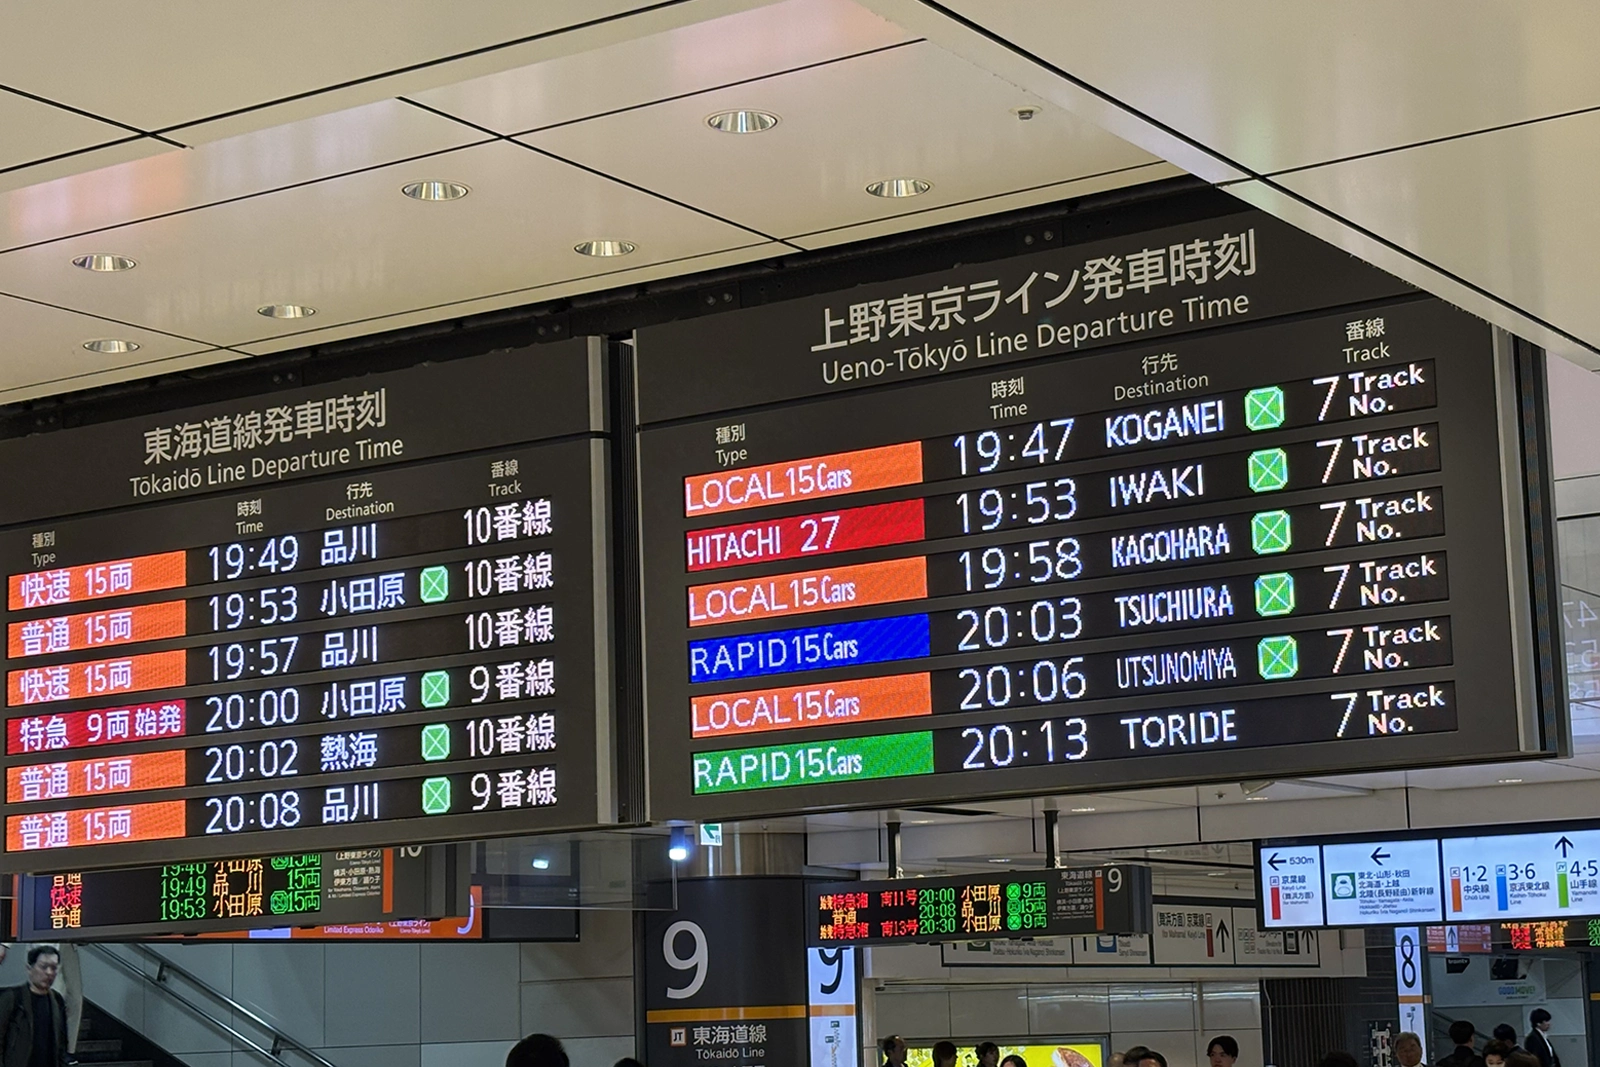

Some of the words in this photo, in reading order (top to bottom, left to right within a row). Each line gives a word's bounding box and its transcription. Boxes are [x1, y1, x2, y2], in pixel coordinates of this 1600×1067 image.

[810, 228, 1256, 353] 上野東京ライン発車時刻
[821, 338, 968, 385] Ueno-Tōkyō
[975, 329, 1028, 359] Line
[1037, 306, 1174, 349] Departure
[1181, 293, 1250, 324] Time
[1345, 316, 1386, 342] 番線
[1141, 352, 1178, 376] 行先
[1342, 341, 1391, 365] Track
[991, 376, 1025, 400] 時刻
[1113, 372, 1209, 401] Destination
[989, 400, 1028, 421] Time
[1349, 394, 1394, 417] No.
[143, 387, 388, 466] 東海道線発車時刻
[954, 418, 1076, 476] 19:47
[1105, 400, 1225, 448] KOGANEI
[1312, 376, 1340, 421] 7
[1348, 363, 1426, 394] Track
[715, 423, 746, 445] 種別
[130, 465, 202, 498] Tōkaidō
[207, 460, 246, 486] Line
[251, 447, 351, 481] Departure
[355, 436, 404, 465] Time
[714, 446, 748, 467] Type
[490, 459, 519, 479] 番線
[1353, 457, 1397, 480] No.
[346, 481, 374, 500] 行先
[488, 479, 522, 497] Track
[687, 525, 782, 567] HITACHI
[800, 515, 841, 553] 27
[956, 478, 1077, 533] 19:53
[1109, 464, 1205, 507] IWAKI
[1316, 438, 1343, 484] 7
[1351, 427, 1429, 456] Track
[236, 498, 263, 518] 時刻
[325, 498, 395, 522] Destination
[235, 517, 264, 535] Time
[1356, 520, 1402, 543] No.
[32, 530, 56, 548] 種別
[959, 537, 1084, 592] 19:58
[1111, 522, 1231, 568] KAGOHARA
[1320, 501, 1347, 546] 7
[1355, 490, 1433, 520] Track
[20, 568, 71, 608] 快速
[85, 560, 133, 596] 15両
[208, 534, 299, 582] 19:49
[320, 522, 378, 567] 品川
[463, 498, 554, 546] 10番線
[31, 549, 56, 568] Type
[20, 618, 71, 657] 普通
[85, 610, 133, 645] 15両
[208, 584, 299, 632] 19:53
[320, 571, 407, 617] 小田原
[463, 551, 555, 598] 10番線
[956, 597, 1083, 651] 20:03
[1114, 584, 1234, 628] TSUCHIURA
[1323, 564, 1350, 610] 7
[1359, 555, 1437, 583] Track
[1360, 583, 1406, 606] No.
[20, 664, 71, 704] 快速
[85, 657, 133, 692] 15両
[208, 636, 300, 682] 19:57
[320, 625, 378, 668] 品川
[464, 606, 555, 652] 10番線
[958, 656, 1087, 711] 20:06
[1116, 646, 1237, 690] UTSUNOMIYA
[1326, 628, 1354, 674] 7
[1362, 620, 1441, 648] Track
[1363, 648, 1409, 671] No.
[19, 714, 70, 752] 特急
[87, 706, 131, 744] 9両
[134, 704, 182, 738] 始発
[205, 687, 300, 733] 20:00
[320, 673, 407, 720] 小田原
[1368, 712, 1414, 735] No.
[961, 717, 1089, 770] 20:13
[1120, 709, 1238, 750] TORIDE
[1331, 692, 1358, 738] 7
[1366, 685, 1445, 712] Track
[20, 762, 70, 801] 普通
[83, 756, 132, 792] 15両
[205, 738, 300, 784] 20:02
[321, 731, 379, 772] 熱海
[465, 712, 557, 759] 10番線
[19, 812, 70, 850] 普通
[83, 806, 132, 842] 15両
[204, 790, 301, 835] 20:08
[322, 782, 379, 825] 品川
[1289, 857, 1315, 865] 530m
[160, 875, 207, 899] 19:49
[287, 867, 322, 890] 15両
[1107, 867, 1123, 893] 9
[1281, 875, 1307, 885] 京葉線
[1463, 883, 1490, 895] 中央線
[1509, 881, 1551, 893] 京浜東北線
[1570, 879, 1598, 890] 山手線
[160, 897, 207, 921] 19:53
[212, 893, 264, 919] 小田原
[287, 889, 321, 912] 15両
[919, 887, 956, 905] 20:00
[1022, 882, 1046, 899] 9両
[919, 903, 957, 919] 20:08
[1020, 898, 1047, 914] 15両
[919, 917, 957, 935] 20:30
[1023, 912, 1047, 929] 9両
[662, 920, 709, 1000] 9
[1400, 934, 1416, 989] 8
[673, 1030, 684, 1042] JT
[692, 1024, 767, 1046] 東海道線
[695, 1046, 740, 1060] Tōkaidō
[742, 1046, 765, 1058] Line
